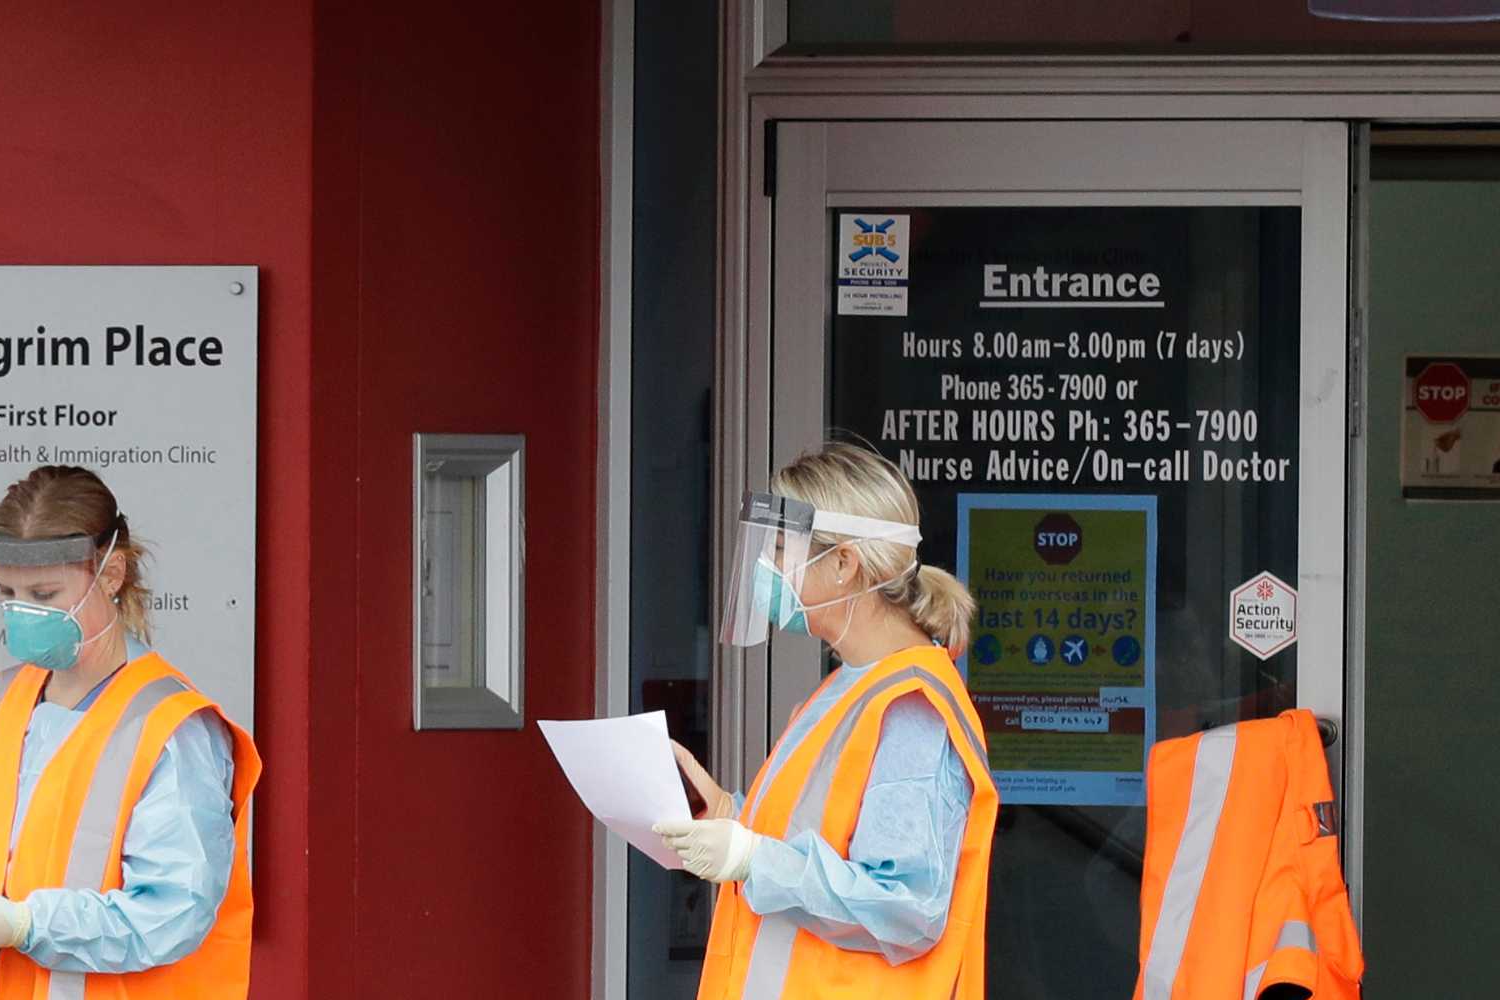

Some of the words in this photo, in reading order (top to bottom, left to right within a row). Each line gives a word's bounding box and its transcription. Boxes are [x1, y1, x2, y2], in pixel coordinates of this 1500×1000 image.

[853, 233, 885, 247] SUB
[887, 233, 897, 247] 5
[843, 267, 903, 276] SECURITY
[984, 265, 1160, 297] Entrance
[106, 325, 222, 366] Place
[904, 332, 962, 357] Hours
[1157, 331, 1176, 360] (7
[1187, 331, 1244, 363] days)
[942, 375, 1000, 400] Phone
[1116, 380, 1138, 400] or
[1418, 386, 1466, 401] STOP
[55, 404, 117, 426] Floor
[882, 410, 958, 440] AFTER
[973, 410, 1054, 441] HOURS
[1069, 410, 1109, 441] Ph:
[37, 446, 51, 466] &
[54, 445, 162, 467] Immigration
[168, 445, 216, 463] Clinic
[899, 449, 973, 481] Nurse
[1203, 450, 1289, 481] Doctor
[1037, 532, 1079, 547] STOP
[985, 568, 1022, 583] Have
[1026, 572, 1056, 586] you
[1061, 568, 1132, 584] returned
[978, 587, 1014, 601] from
[1020, 590, 1088, 602] overseas
[1093, 588, 1108, 601] in
[1112, 588, 1139, 602] the
[979, 606, 1025, 629] last
[1034, 608, 1060, 629] 14
[1068, 607, 1138, 635] days?
[1237, 603, 1280, 616] Action
[1236, 616, 1293, 632] Security
